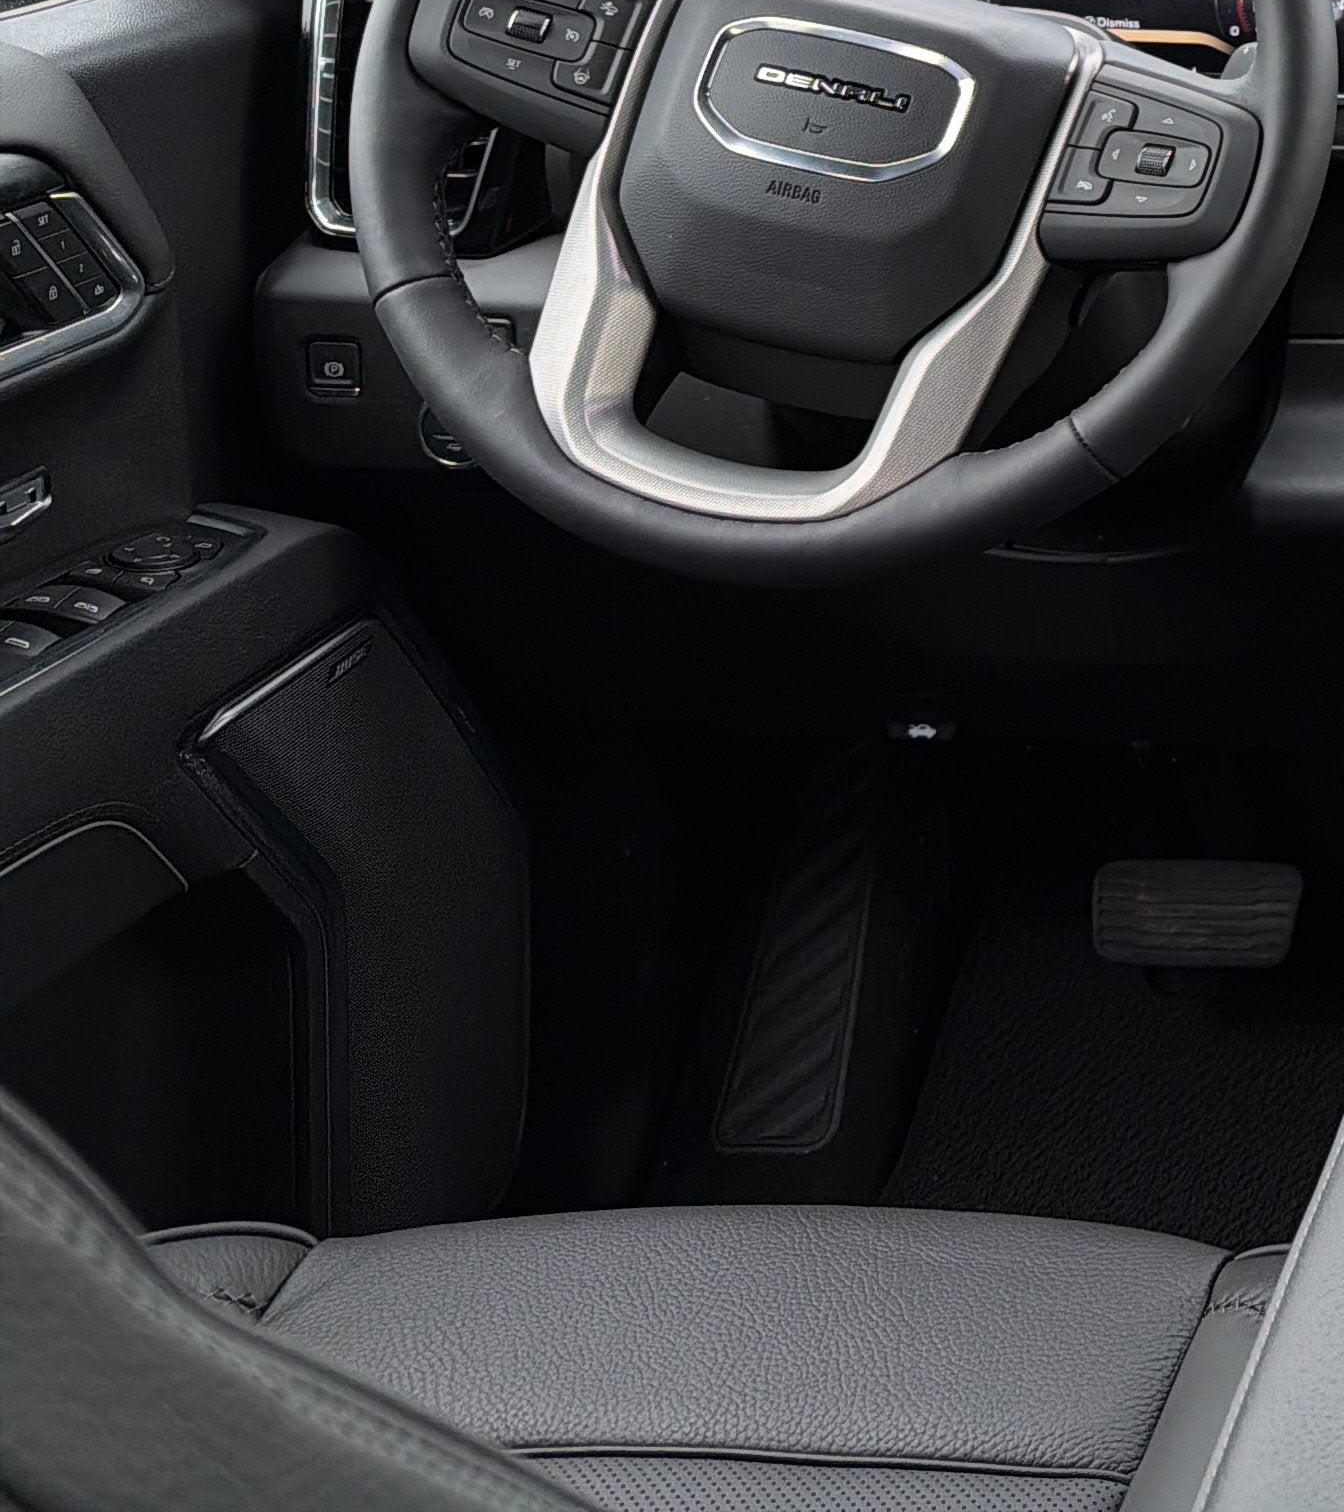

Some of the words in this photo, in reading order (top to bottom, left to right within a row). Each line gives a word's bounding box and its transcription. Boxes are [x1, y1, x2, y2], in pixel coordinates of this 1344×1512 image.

[1097, 17, 1141, 29] Dismiss
[755, 65, 911, 112] DENALI
[765, 179, 823, 204] AIRBAG
[37, 214, 49, 227] SET
